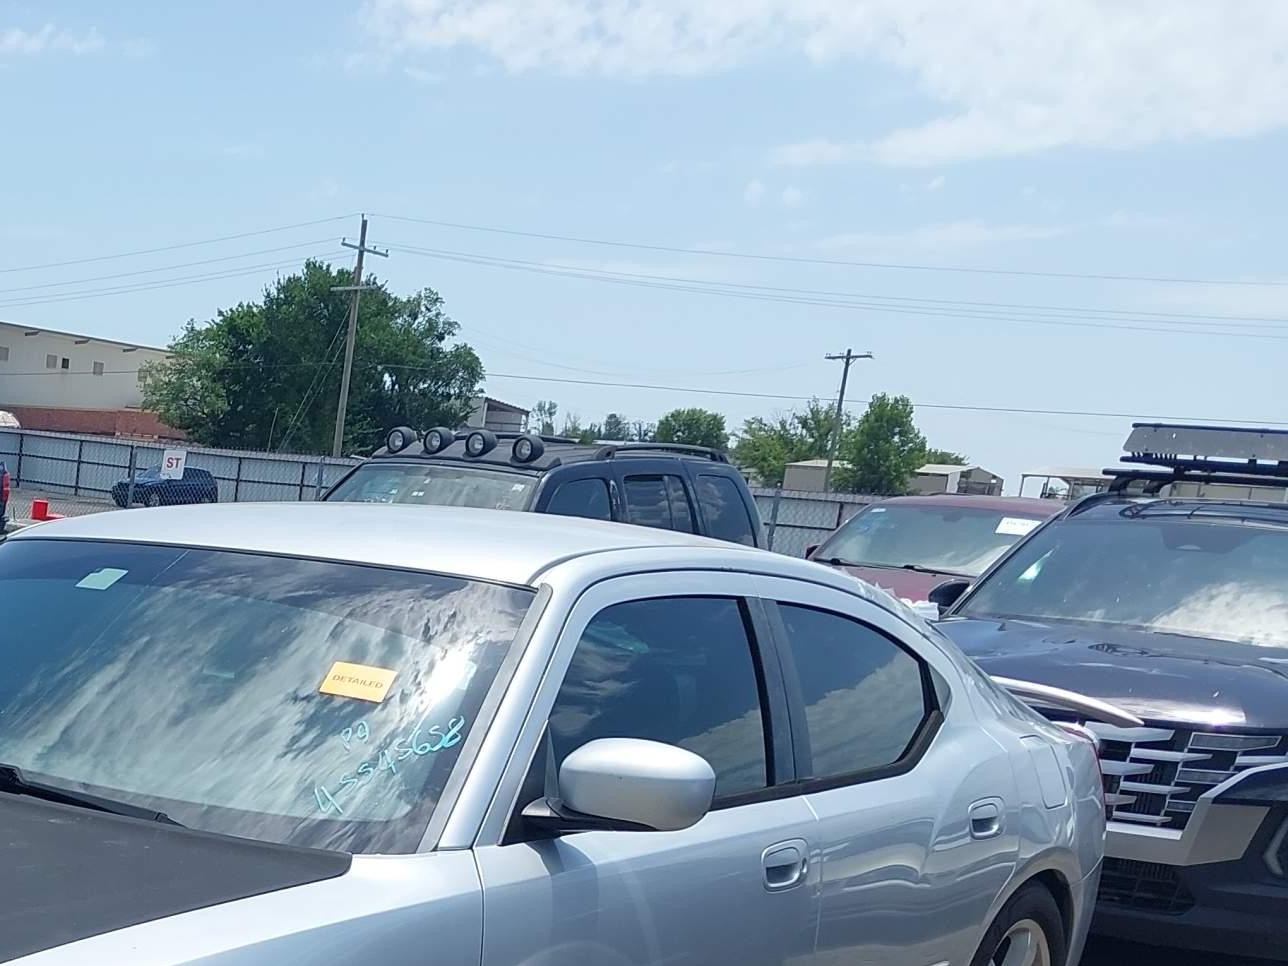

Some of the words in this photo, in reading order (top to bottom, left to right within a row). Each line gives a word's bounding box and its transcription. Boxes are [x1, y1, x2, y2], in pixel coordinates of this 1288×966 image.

[166, 457, 182, 469] ST
[331, 673, 385, 690] DETAILED
[313, 715, 465, 814] 45545658
